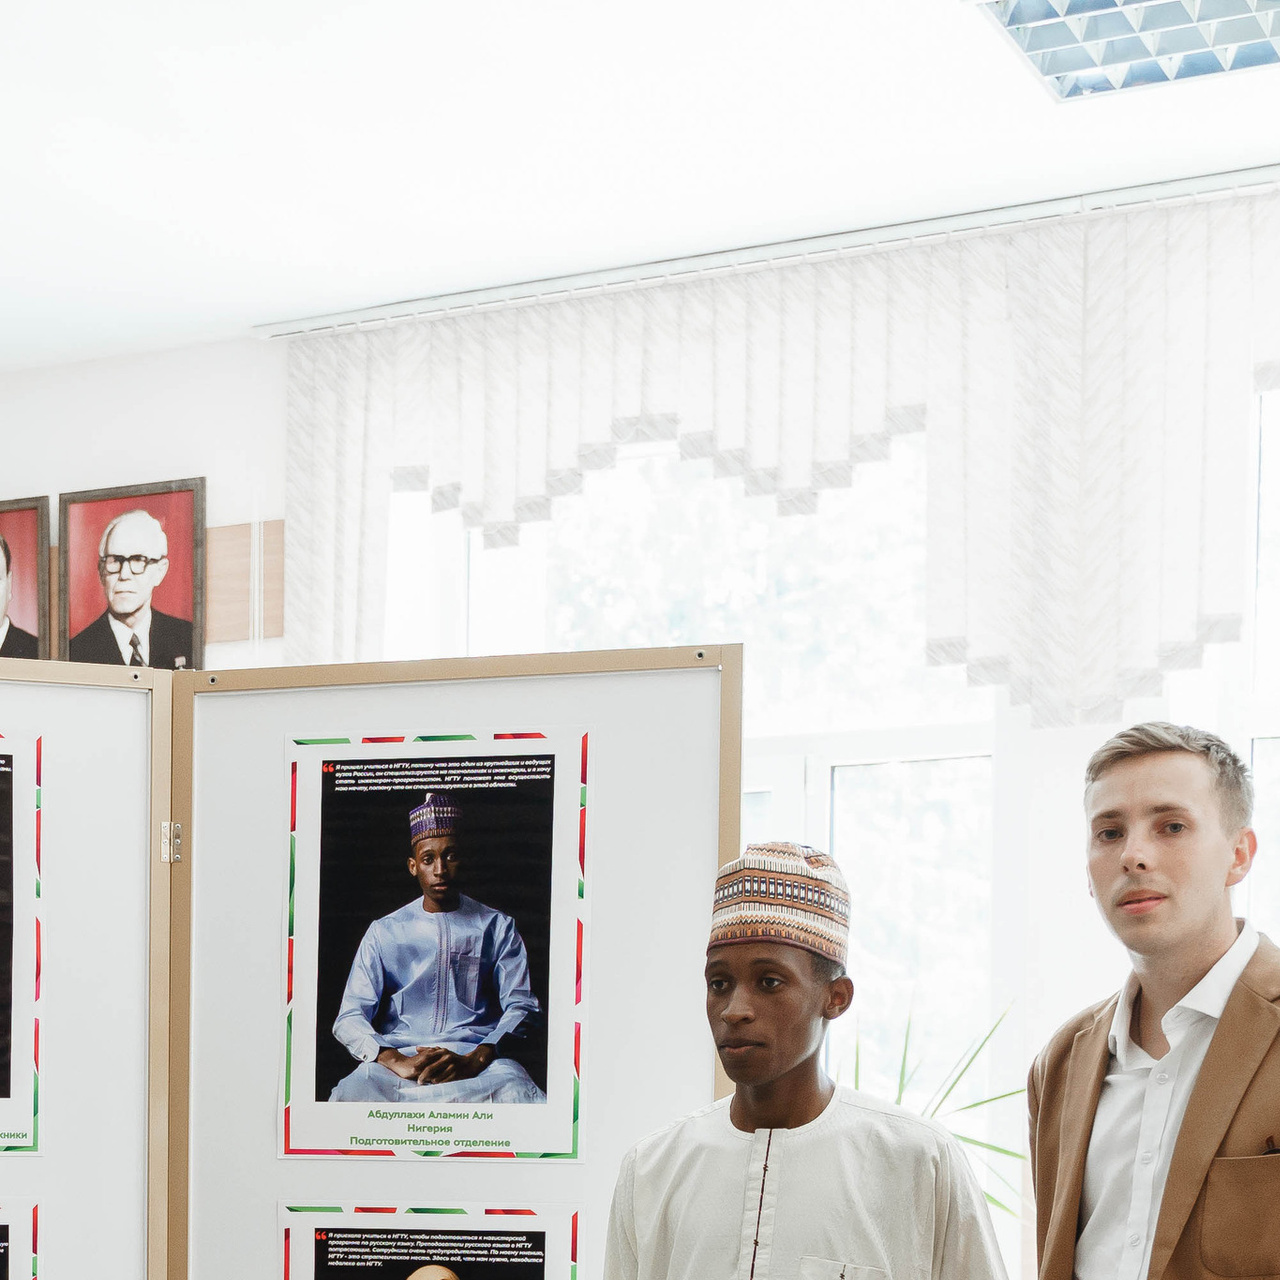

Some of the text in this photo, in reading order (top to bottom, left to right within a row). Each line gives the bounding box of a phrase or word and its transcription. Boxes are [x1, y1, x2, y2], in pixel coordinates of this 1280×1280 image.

[367, 1110, 493, 1121] Абдуллахи Аламин Али
[407, 1124, 453, 1135] Нигерия
[350, 1137, 511, 1148] Подготовительное отделение
